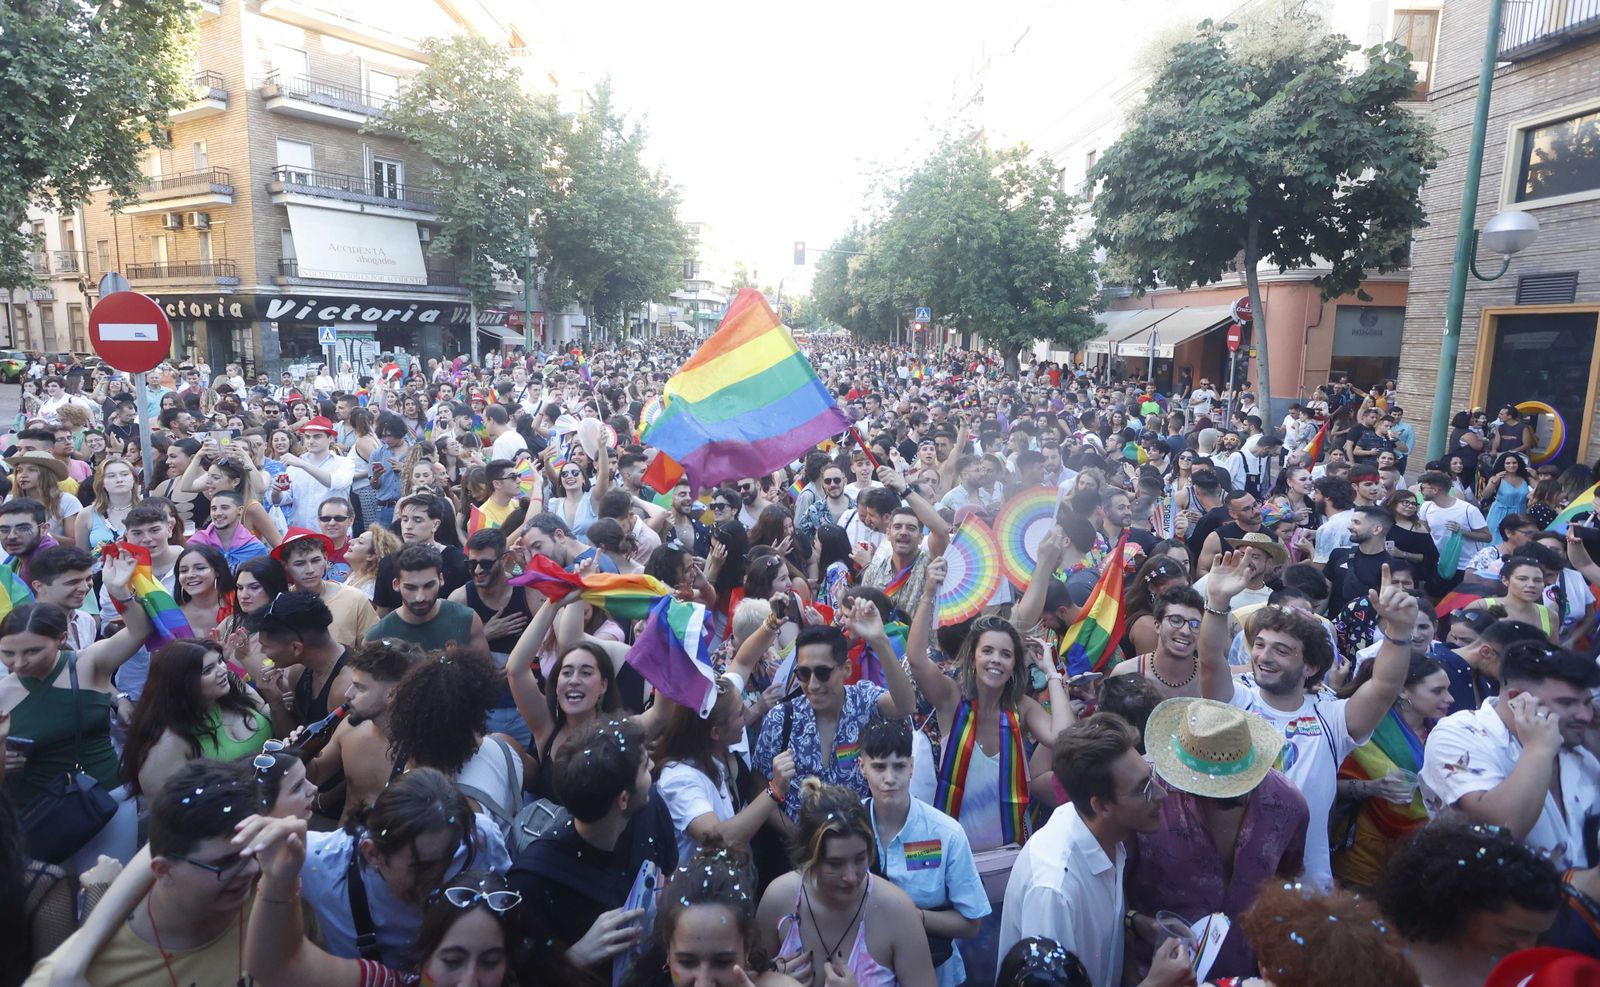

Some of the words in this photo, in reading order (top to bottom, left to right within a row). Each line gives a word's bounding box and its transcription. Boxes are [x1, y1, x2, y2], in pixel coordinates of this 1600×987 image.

[328, 242, 386, 256] ACCIDENTA
[356, 255, 397, 266] abogados
[155, 297, 243, 318] ctoria
[265, 299, 440, 322] Victoria
[451, 307, 503, 323] Vicoria
[1163, 504, 1171, 532] AIRBUS
